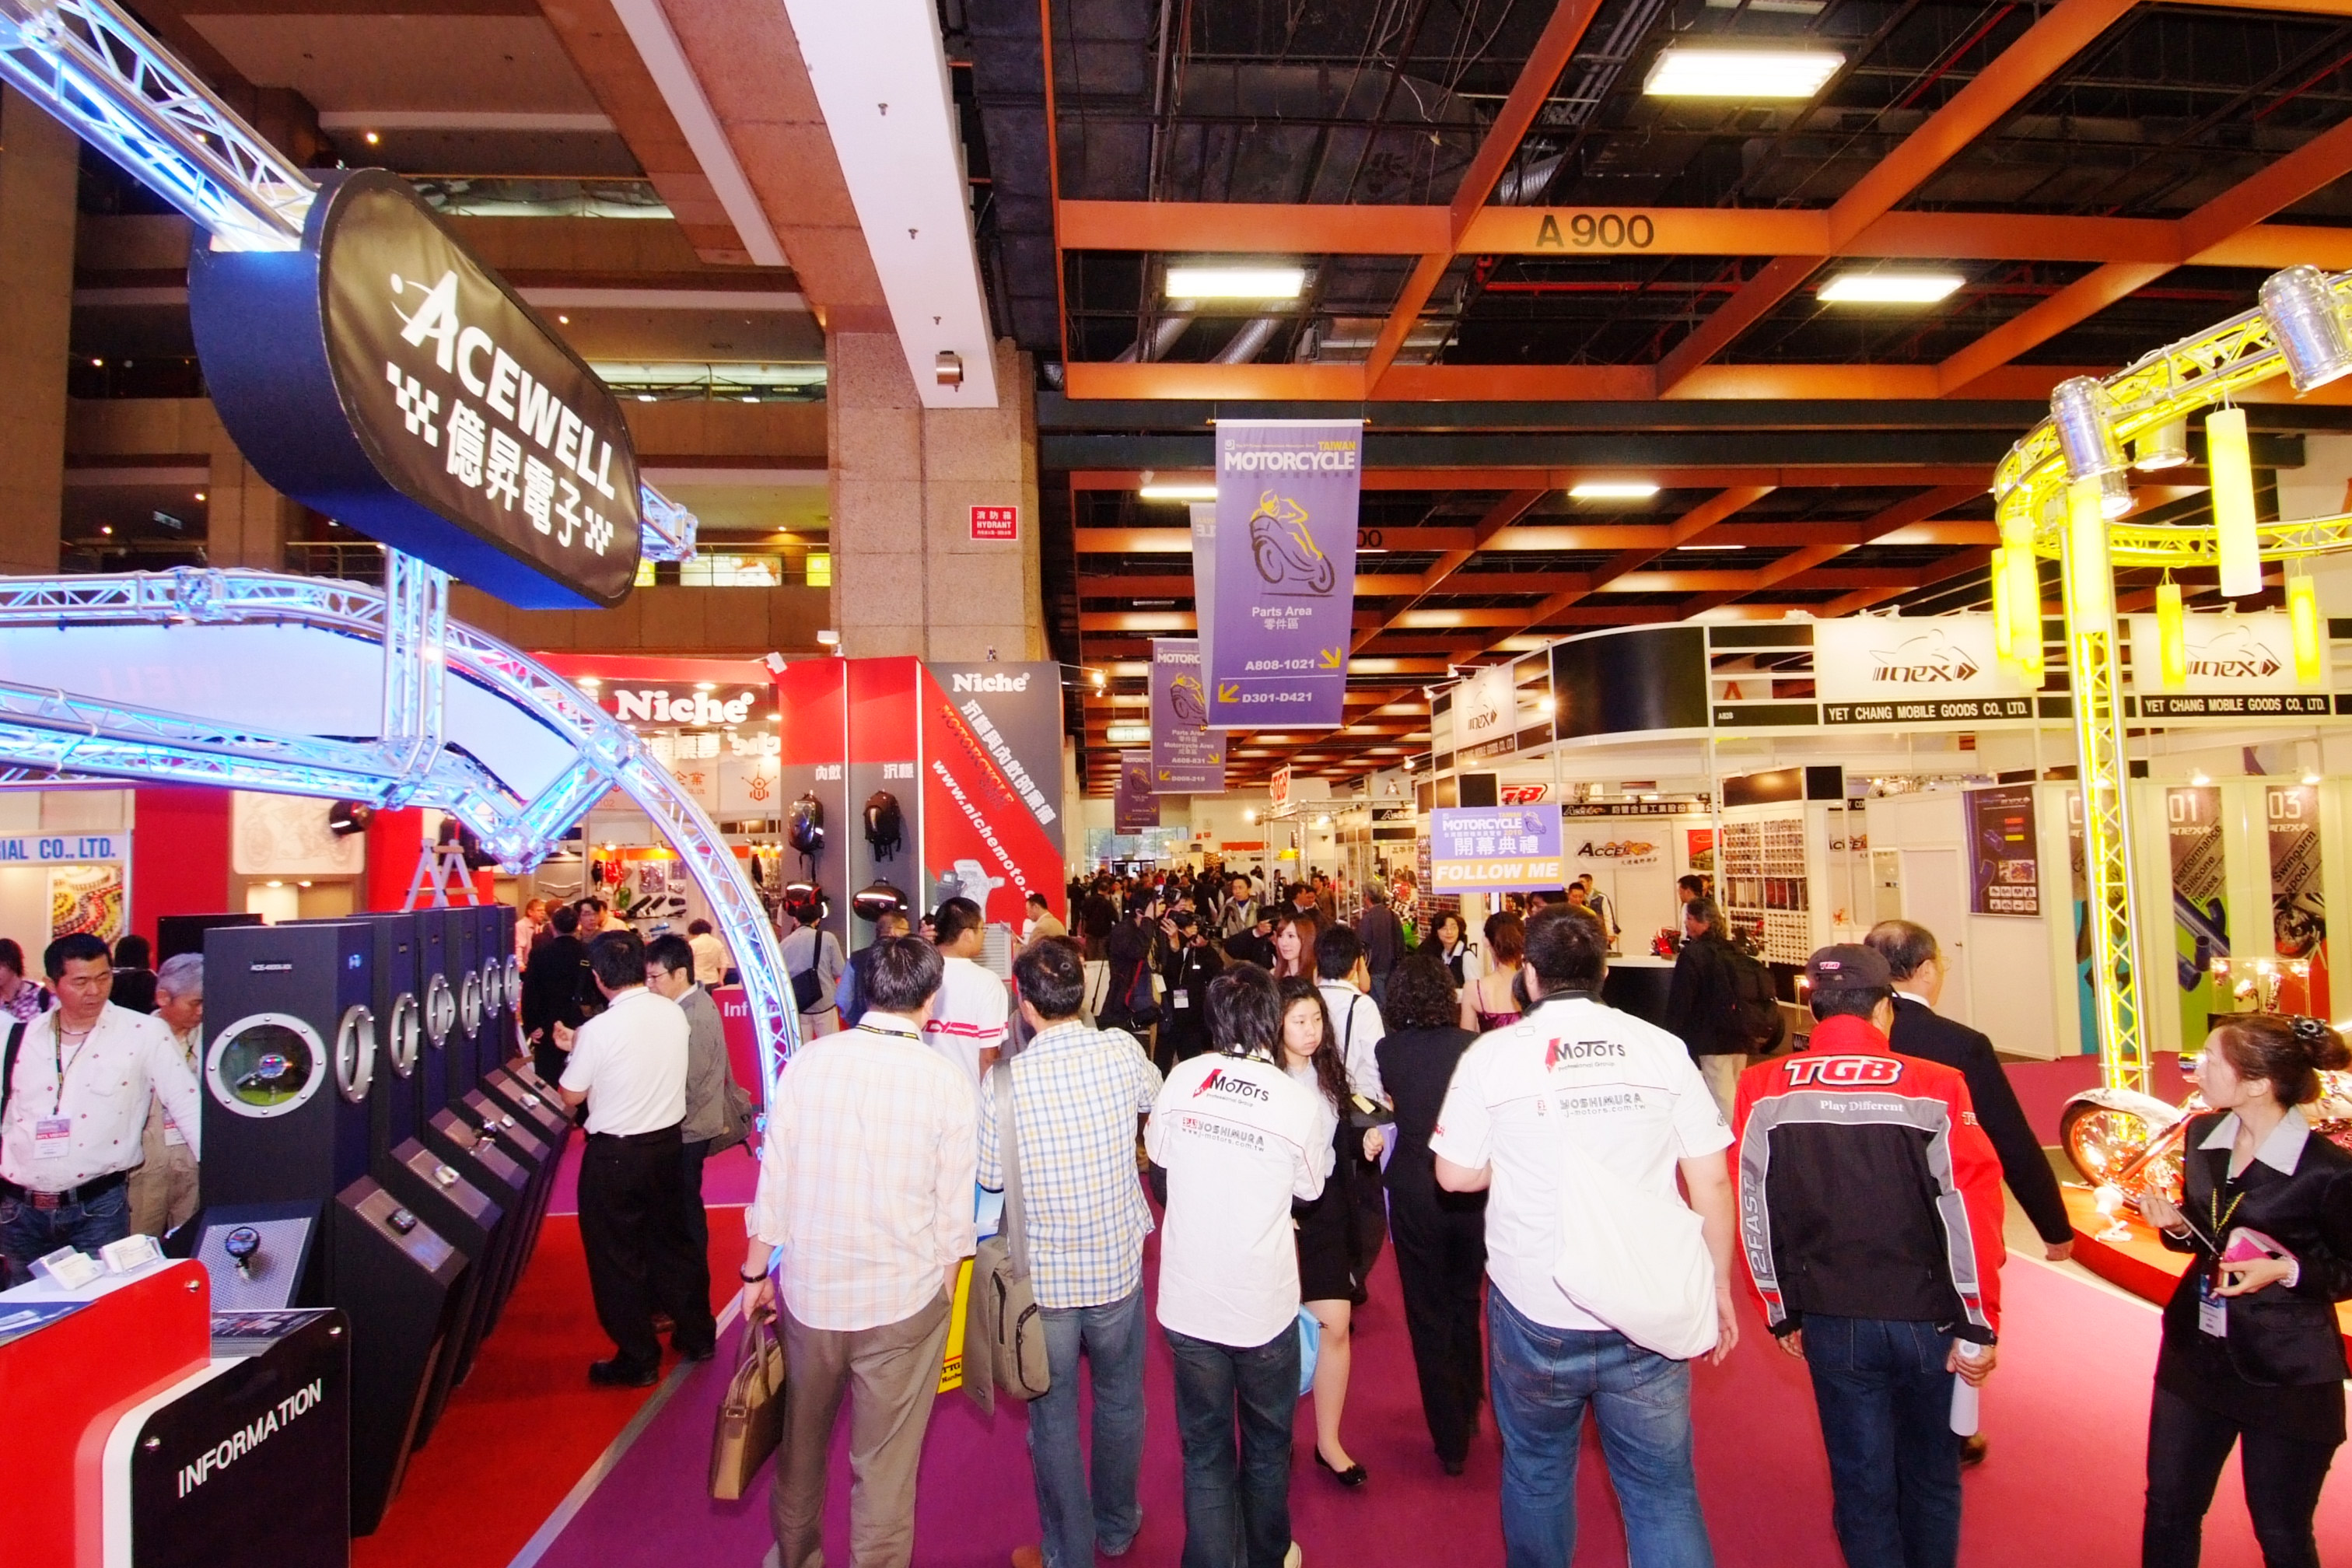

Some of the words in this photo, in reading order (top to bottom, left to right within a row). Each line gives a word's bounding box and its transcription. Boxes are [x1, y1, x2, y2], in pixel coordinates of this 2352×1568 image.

[400, 269, 615, 500] ACEWELL
[1318, 441, 1356, 451] TAIWAN
[1224, 451, 1355, 471] MOTORCYCLE
[446, 398, 582, 548] 億昇電子
[976, 520, 1012, 529] HYDRANT
[1252, 607, 1282, 617] Parts
[1285, 606, 1312, 616] Area
[1264, 618, 1300, 630] 零件區
[1157, 653, 1200, 664] MOTORC
[1244, 659, 1315, 671] A808-1021
[1242, 692, 1312, 703] D301-D421
[2145, 700, 2165, 712] YET
[2170, 699, 2205, 712] CHANG
[2208, 698, 2244, 712] MOBILE
[2248, 698, 2281, 711] GOODS
[2307, 698, 2326, 711] LTD.
[1829, 707, 1850, 720] YET
[1855, 705, 1892, 720] CHANG
[1897, 705, 1935, 719] MOBILE
[1941, 703, 1978, 717] GOODS
[2007, 702, 2028, 715] LTD.
[938, 704, 1015, 804] MOTORCYCLE
[1501, 785, 1548, 803] GB
[2168, 794, 2198, 822] 01
[2268, 791, 2301, 819] 03
[932, 759, 1035, 899] www.nichemoto.c
[1442, 818, 1522, 831] MOTORCYCLE
[0, 839, 29, 859] IAL
[79, 837, 116, 858] LTD.
[1454, 835, 1539, 856] 開幕典禮
[2273, 829, 2317, 884] Swingarm
[1436, 863, 1524, 881] FOLLOW
[1527, 862, 1559, 878] ME
[2182, 855, 2216, 895] Silicone
[2284, 863, 2311, 895] spool
[2193, 874, 2219, 905] hoses
[1820, 961, 1840, 970] TGB
[1783, 1054, 1905, 1086] TGB
[1559, 1093, 1643, 1110] YOSHIMURA
[1820, 1100, 1846, 1113] Play
[1849, 1101, 1905, 1112] Different
[1197, 1121, 1265, 1146] YOSHIMURA
[1743, 1176, 1768, 1274] 2FAST
[178, 1377, 322, 1499] INFORMATION
